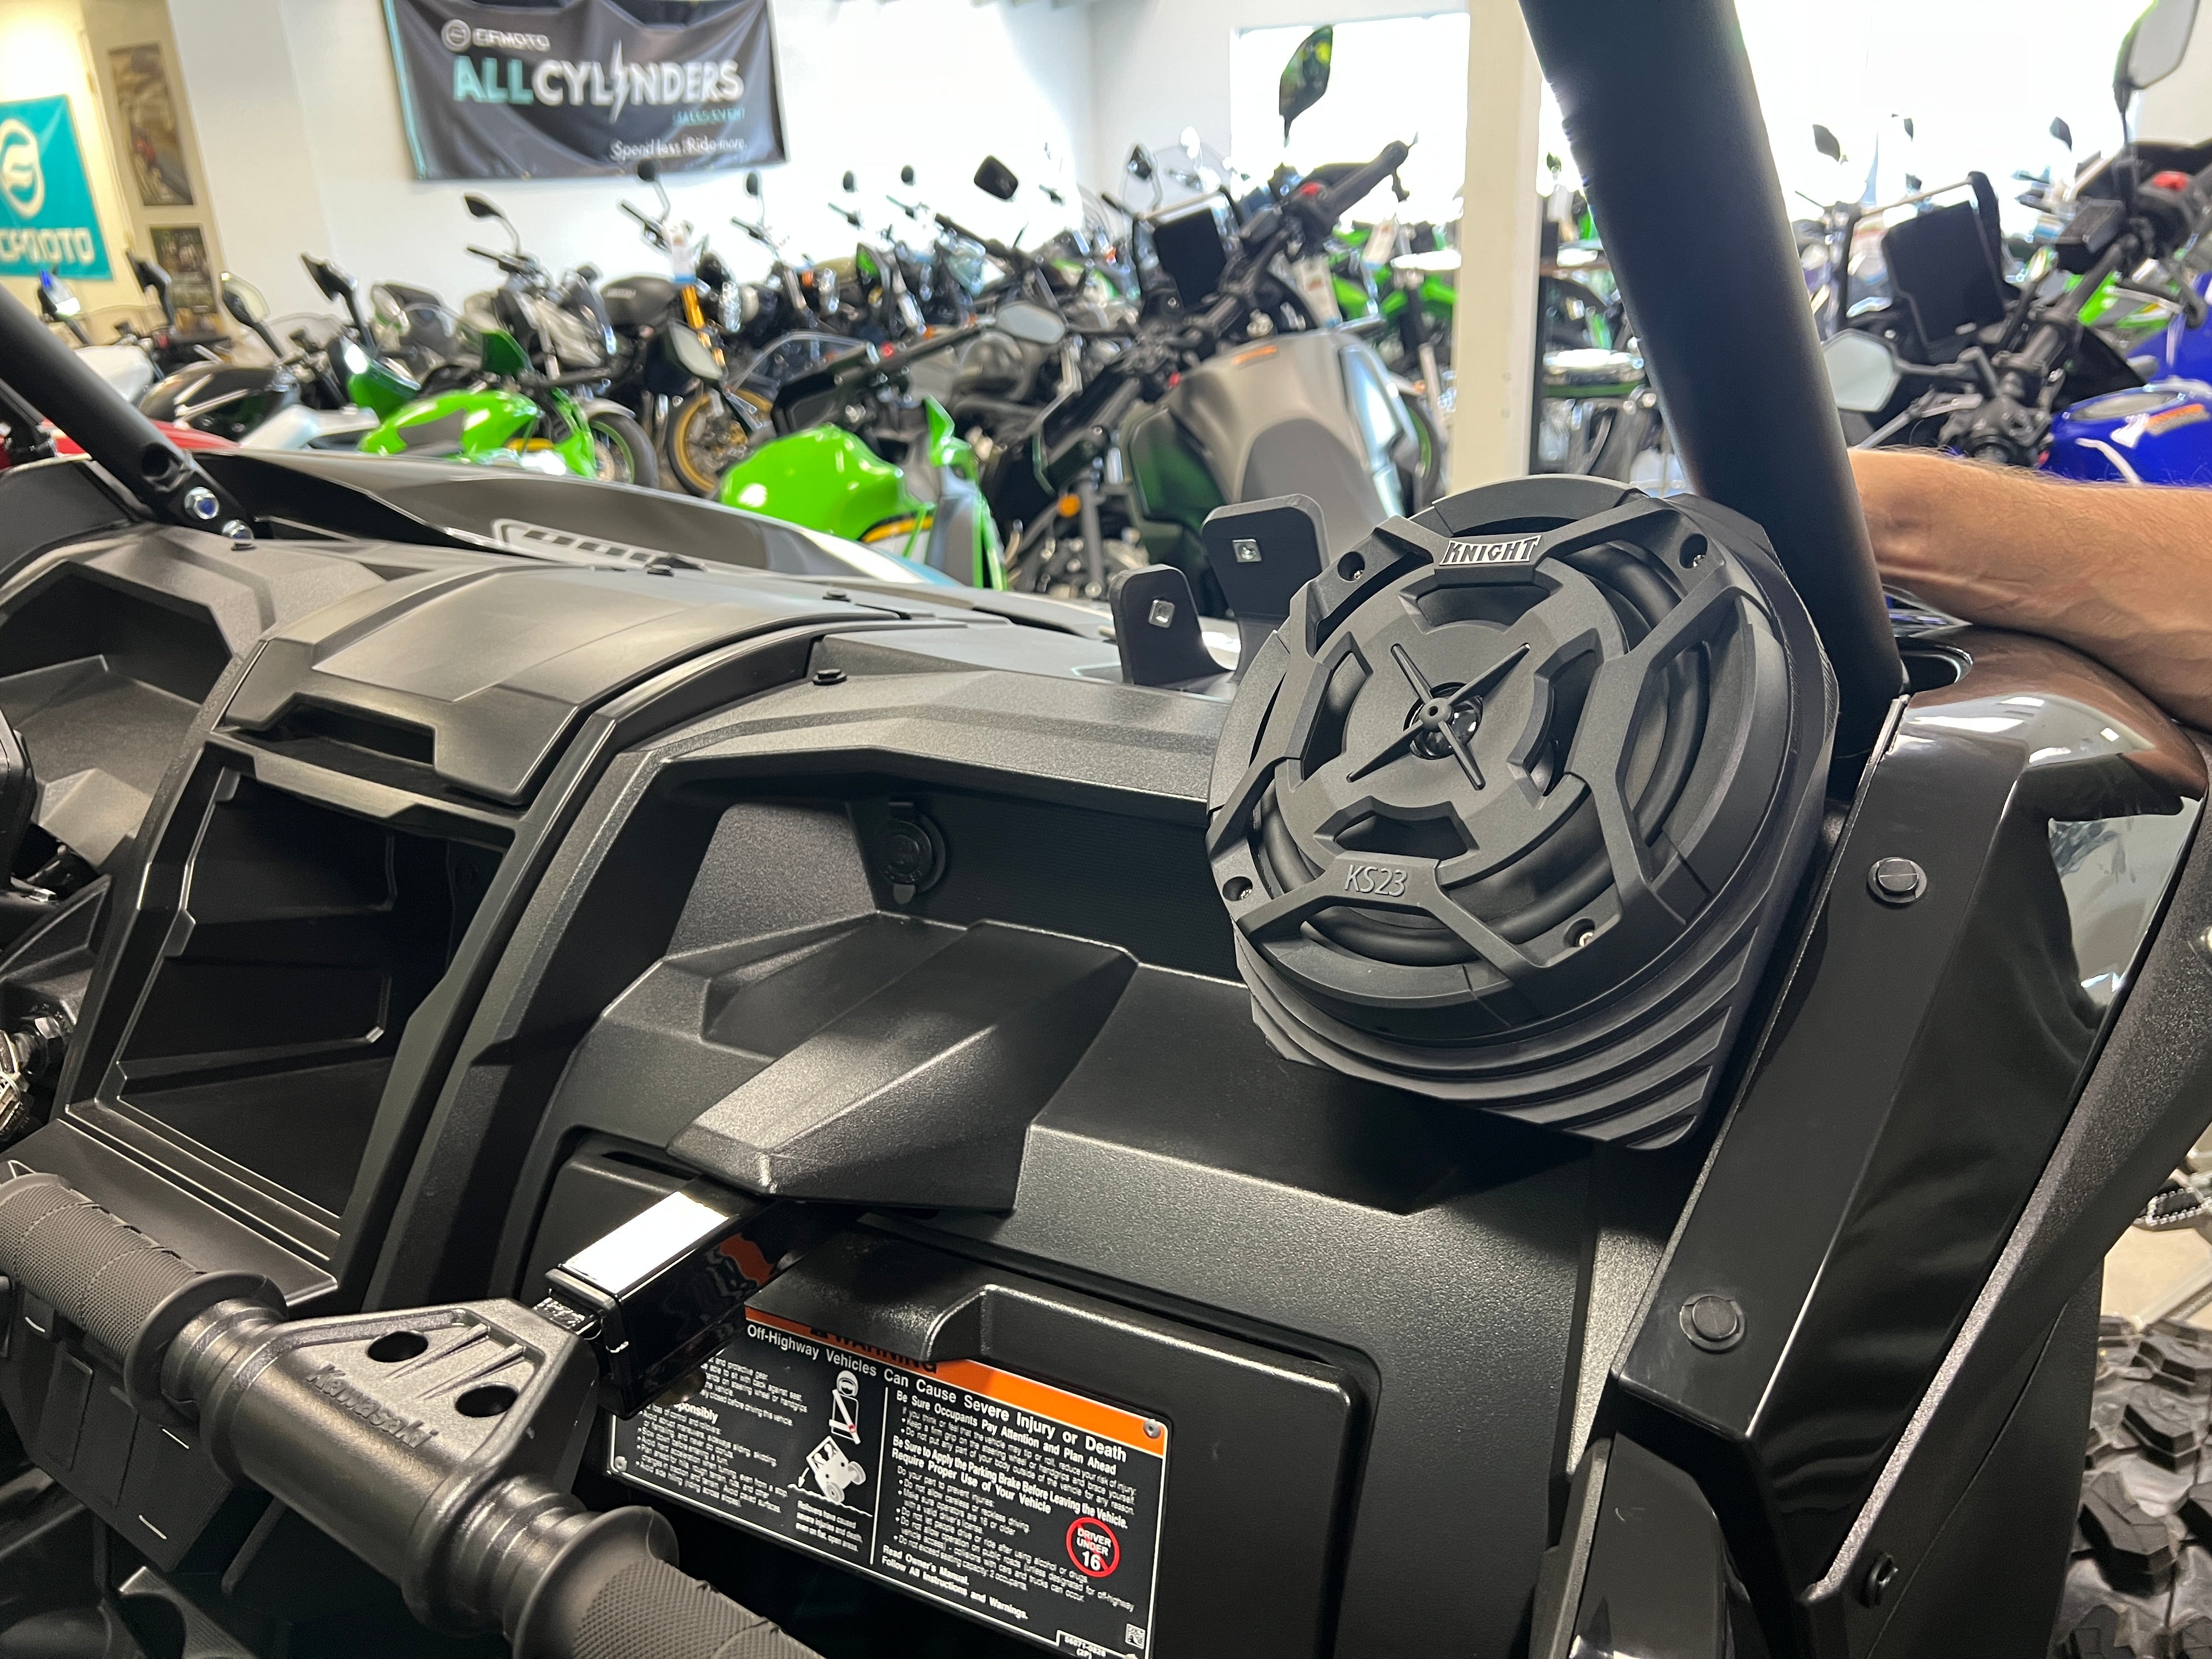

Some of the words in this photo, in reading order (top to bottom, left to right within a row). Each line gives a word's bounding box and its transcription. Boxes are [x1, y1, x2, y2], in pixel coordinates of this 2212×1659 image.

[1441, 536, 1540, 565] KNIGHT
[1344, 864, 1408, 898] KS23
[306, 1363, 439, 1449] Kawasaki
[747, 1324, 819, 1360] Off-Highway
[826, 1348, 877, 1376] Vehicles
[884, 1368, 909, 1387] Can
[916, 1378, 956, 1403] Cause
[963, 1394, 1009, 1421] Severe
[1016, 1411, 1056, 1440] Injury
[1062, 1431, 1078, 1444] or
[1085, 1435, 1126, 1462] Death
[896, 1390, 908, 1403] Be
[911, 1395, 930, 1410] Sure
[934, 1402, 978, 1427] Occupants
[981, 1418, 998, 1436] Pay
[1000, 1425, 1039, 1448] Attention
[1042, 1442, 1060, 1455] and
[1063, 1447, 1084, 1464] Plan
[1086, 1455, 1116, 1476] Ahead
[891, 1447, 924, 1468] Require
[927, 1459, 957, 1480] Proper
[960, 1471, 978, 1487] Use
[981, 1481, 992, 1492] of
[995, 1483, 1015, 1500] Your
[1018, 1492, 1051, 1514] Vehicle
[893, 1435, 904, 1448] Be
[904, 1438, 922, 1455] Sure
[922, 1446, 931, 1458] to
[931, 1448, 954, 1468] Apply
[954, 1457, 967, 1471] the
[968, 1461, 997, 1486] Parking
[998, 1471, 1022, 1490] Brake
[1022, 1480, 1048, 1500] Before
[1049, 1490, 1081, 1514] Leaving
[1081, 1502, 1096, 1517] the
[1096, 1506, 1128, 1529] Vehicle.
[1076, 1526, 1112, 1548] DRIVER
[1076, 1536, 1109, 1556] UNDER
[882, 1544, 902, 1559] Read
[905, 1553, 936, 1572] Owner's
[1081, 1548, 1102, 1572] 16
[881, 1555, 906, 1572] Follow
[909, 1566, 920, 1577] All
[922, 1571, 967, 1596] Instructions
[970, 1591, 986, 1603] and
